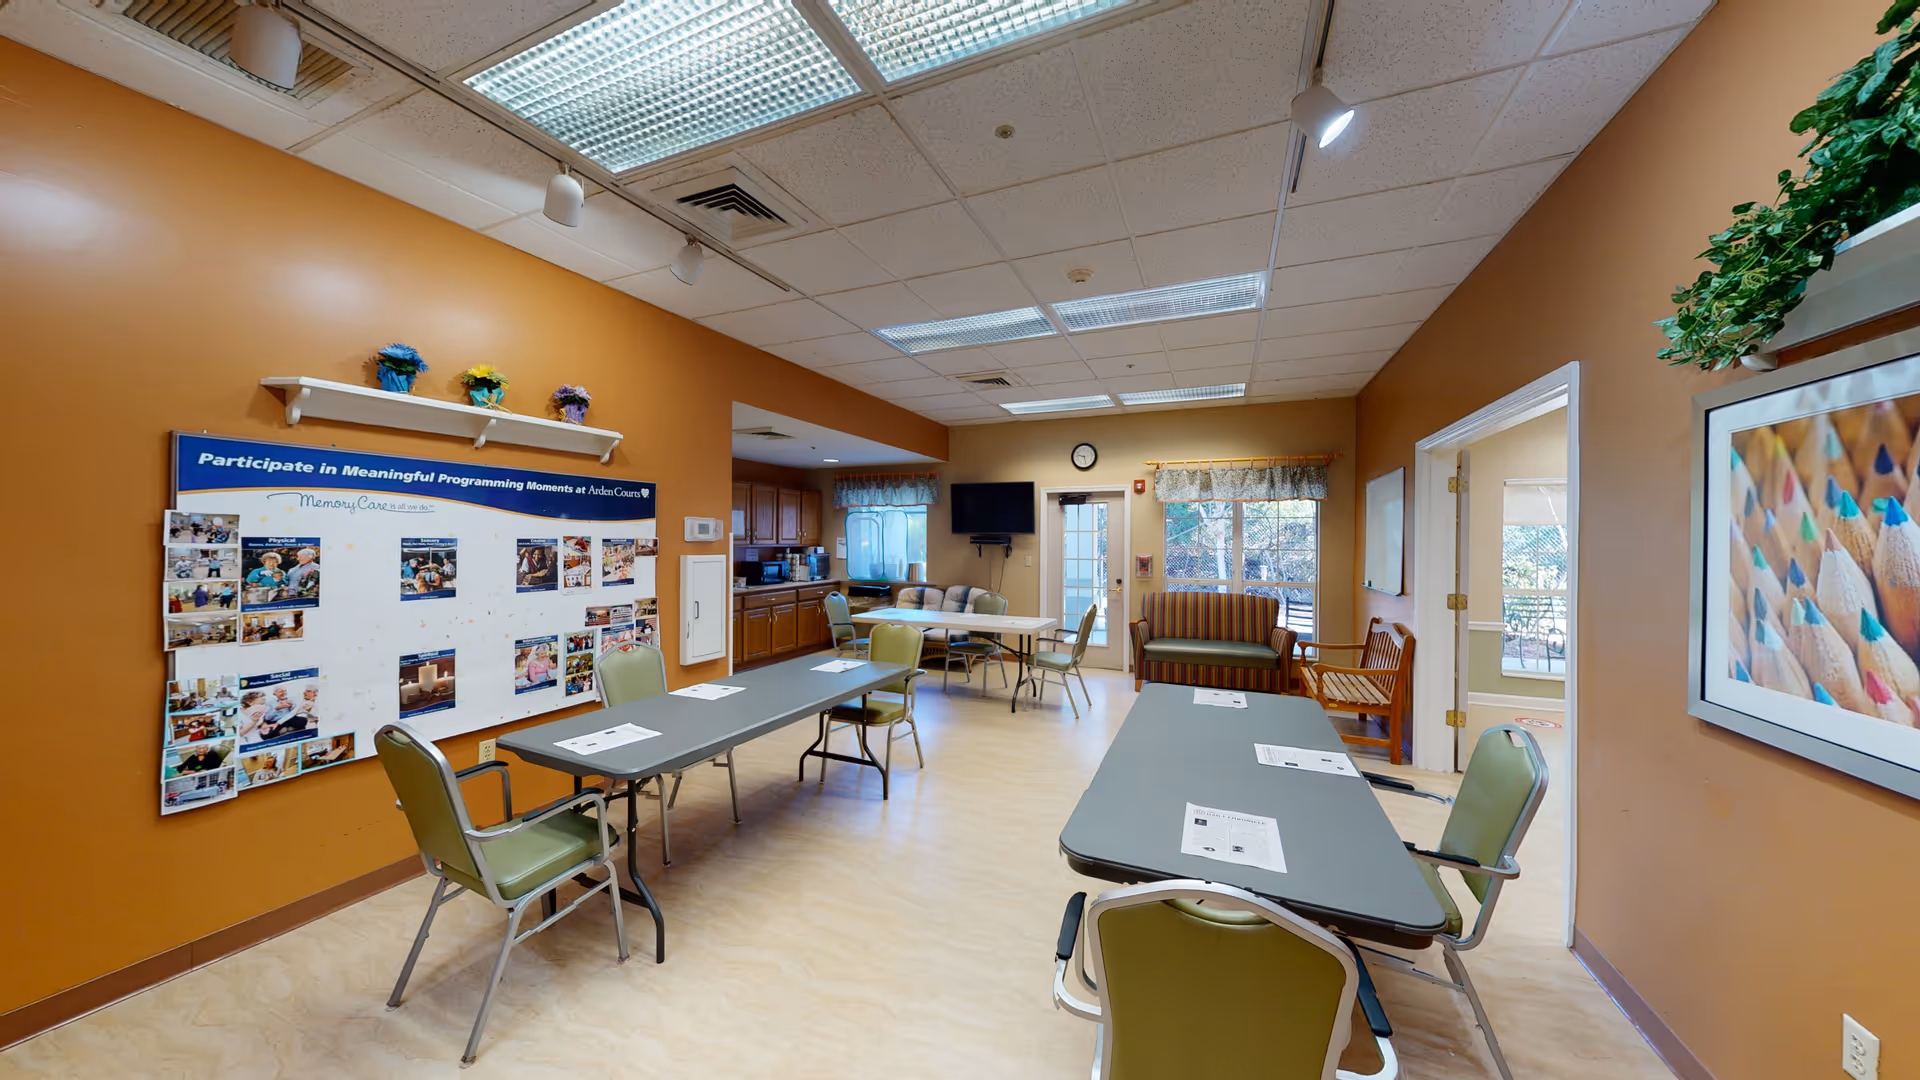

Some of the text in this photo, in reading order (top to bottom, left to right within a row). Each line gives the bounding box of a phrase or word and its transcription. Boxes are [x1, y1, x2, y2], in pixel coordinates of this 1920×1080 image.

[198, 452, 314, 473] Participate
[319, 462, 337, 475] in
[341, 465, 434, 483] Meaningful
[437, 473, 524, 491] Programming
[526, 481, 573, 493] Moments
[587, 486, 641, 498] Arden Courts
[299, 494, 357, 514] Memory
[357, 495, 388, 510] Care
[270, 671, 291, 679] Social
